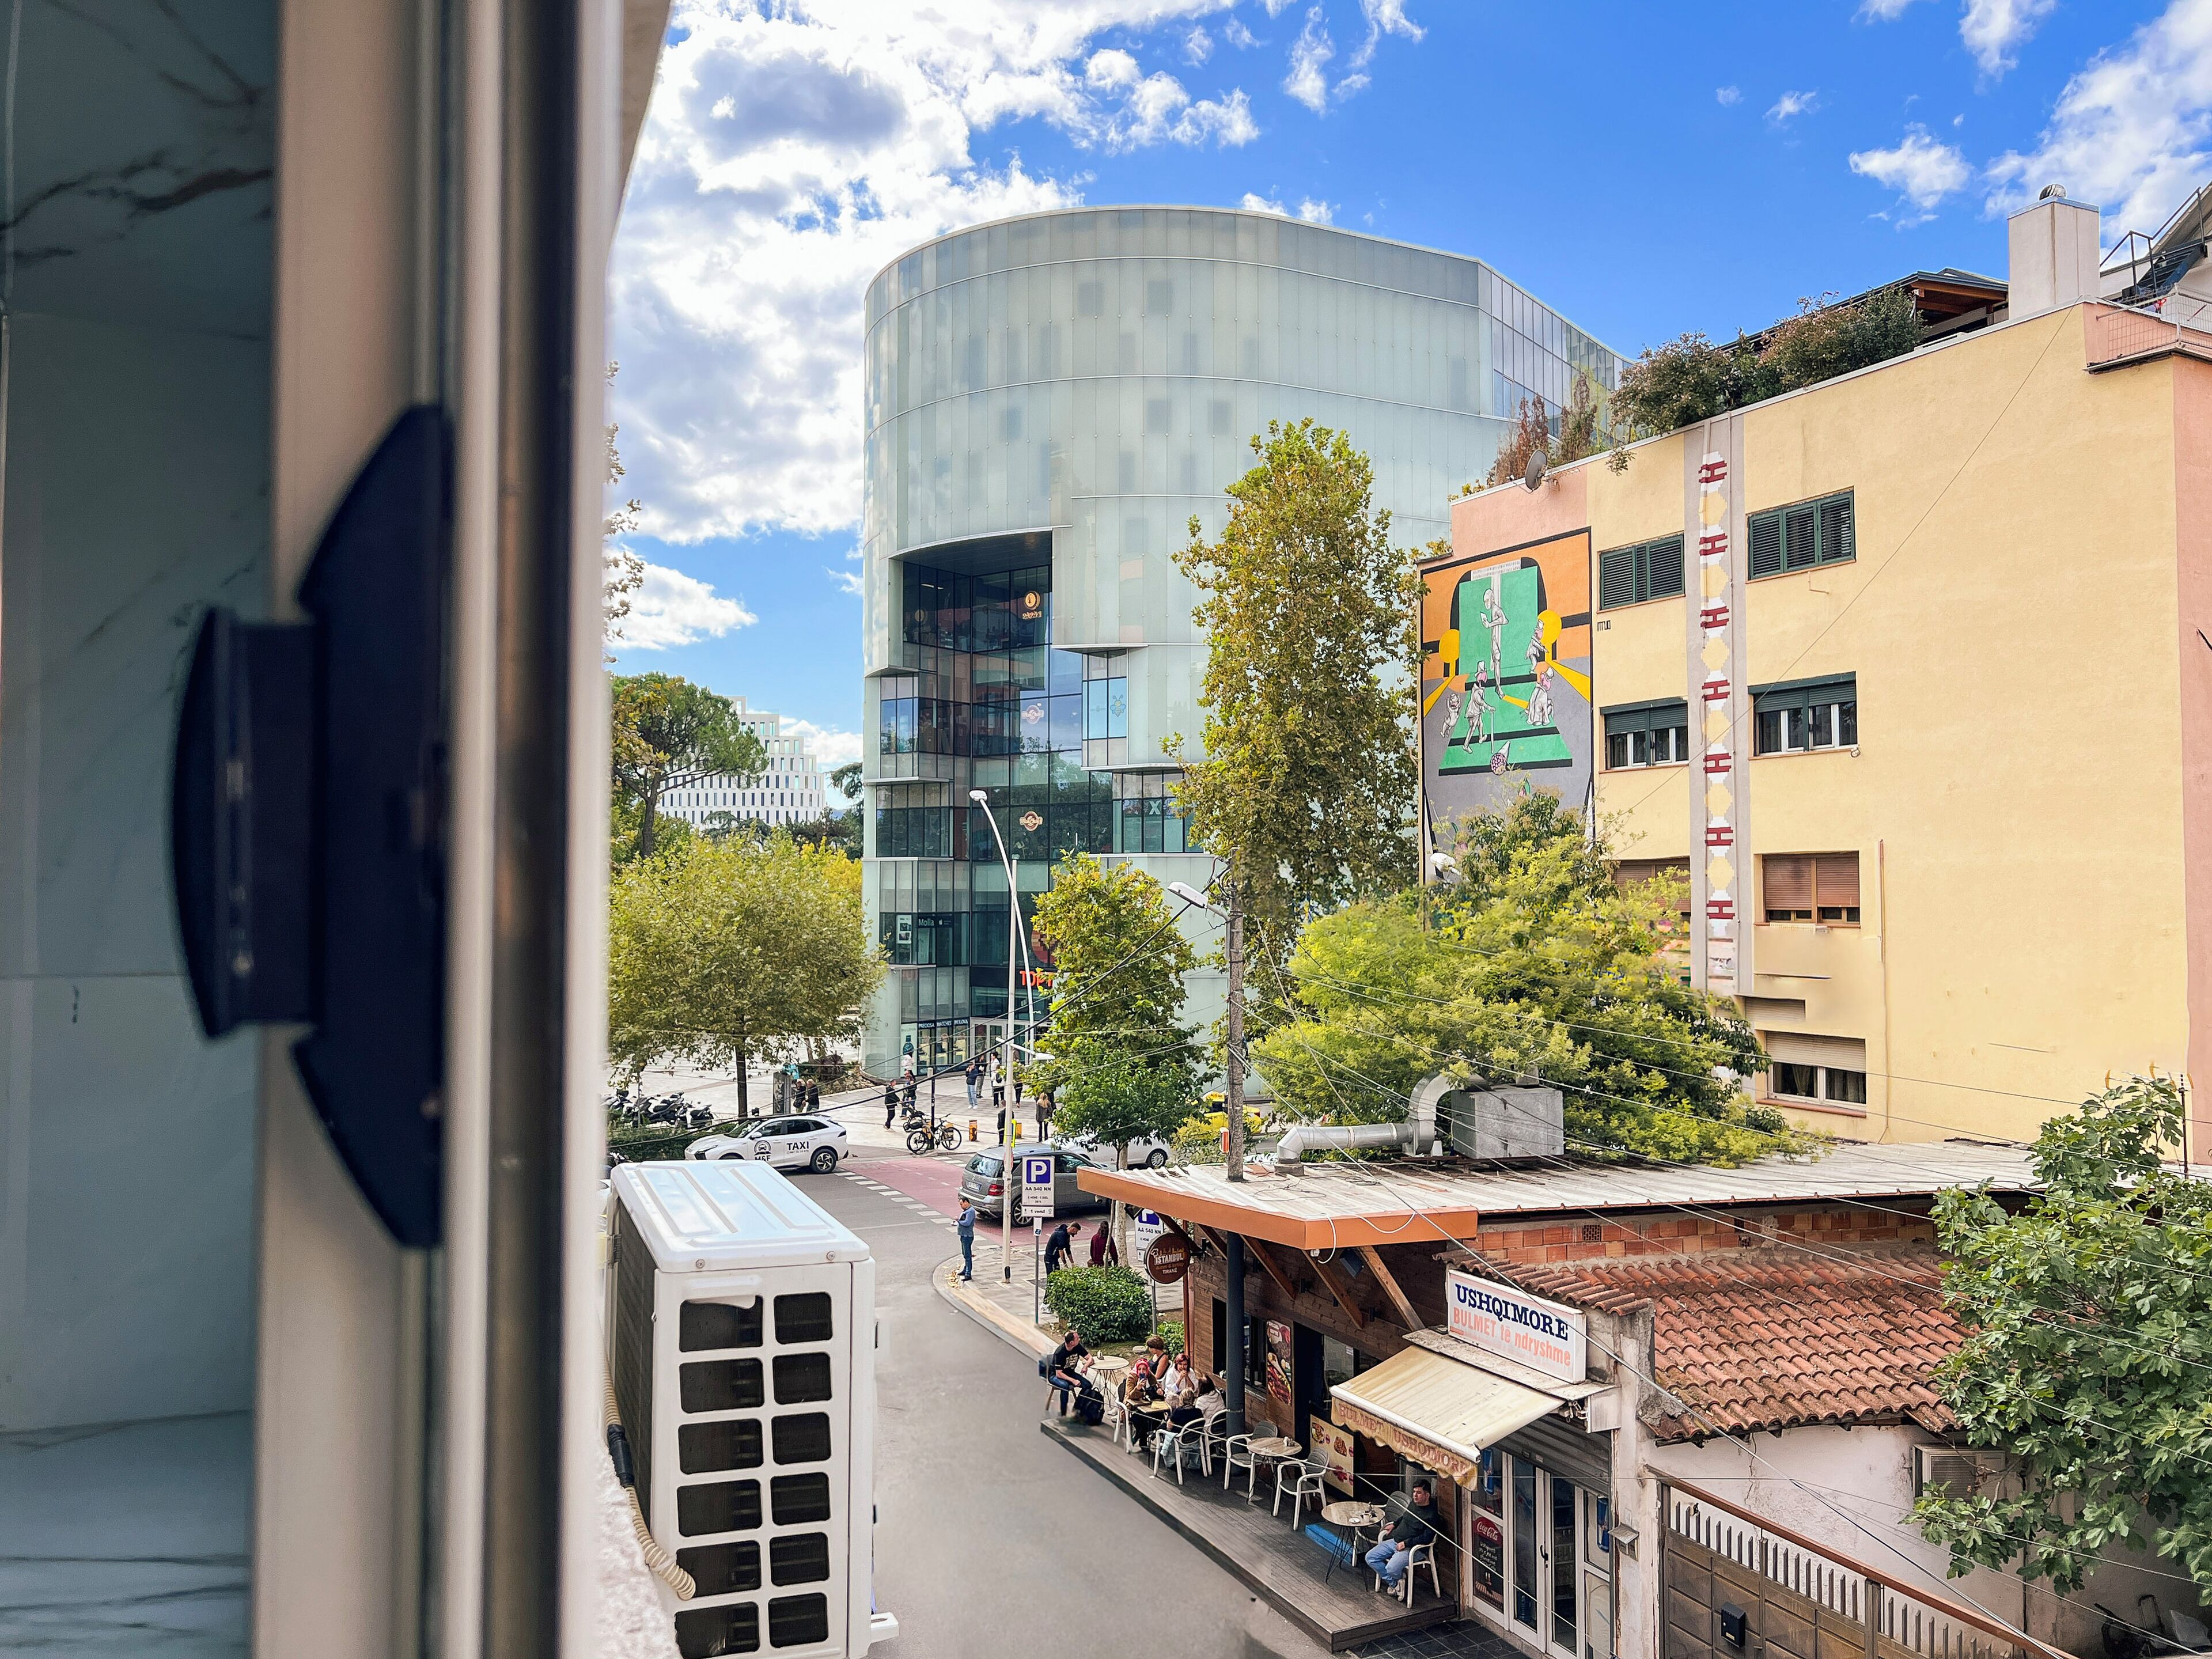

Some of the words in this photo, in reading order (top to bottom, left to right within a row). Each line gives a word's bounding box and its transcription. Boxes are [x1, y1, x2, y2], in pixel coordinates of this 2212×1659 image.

[786, 1141, 809, 1150] TAXI
[1031, 1161, 1047, 1182] P
[1455, 1283, 1568, 1341] USHQIMORE
[1453, 1306, 1496, 1338] BULMET
[1501, 1324, 1511, 1343] të
[1514, 1331, 1571, 1366] ndryshme
[1338, 1403, 1384, 1434] BULMET
